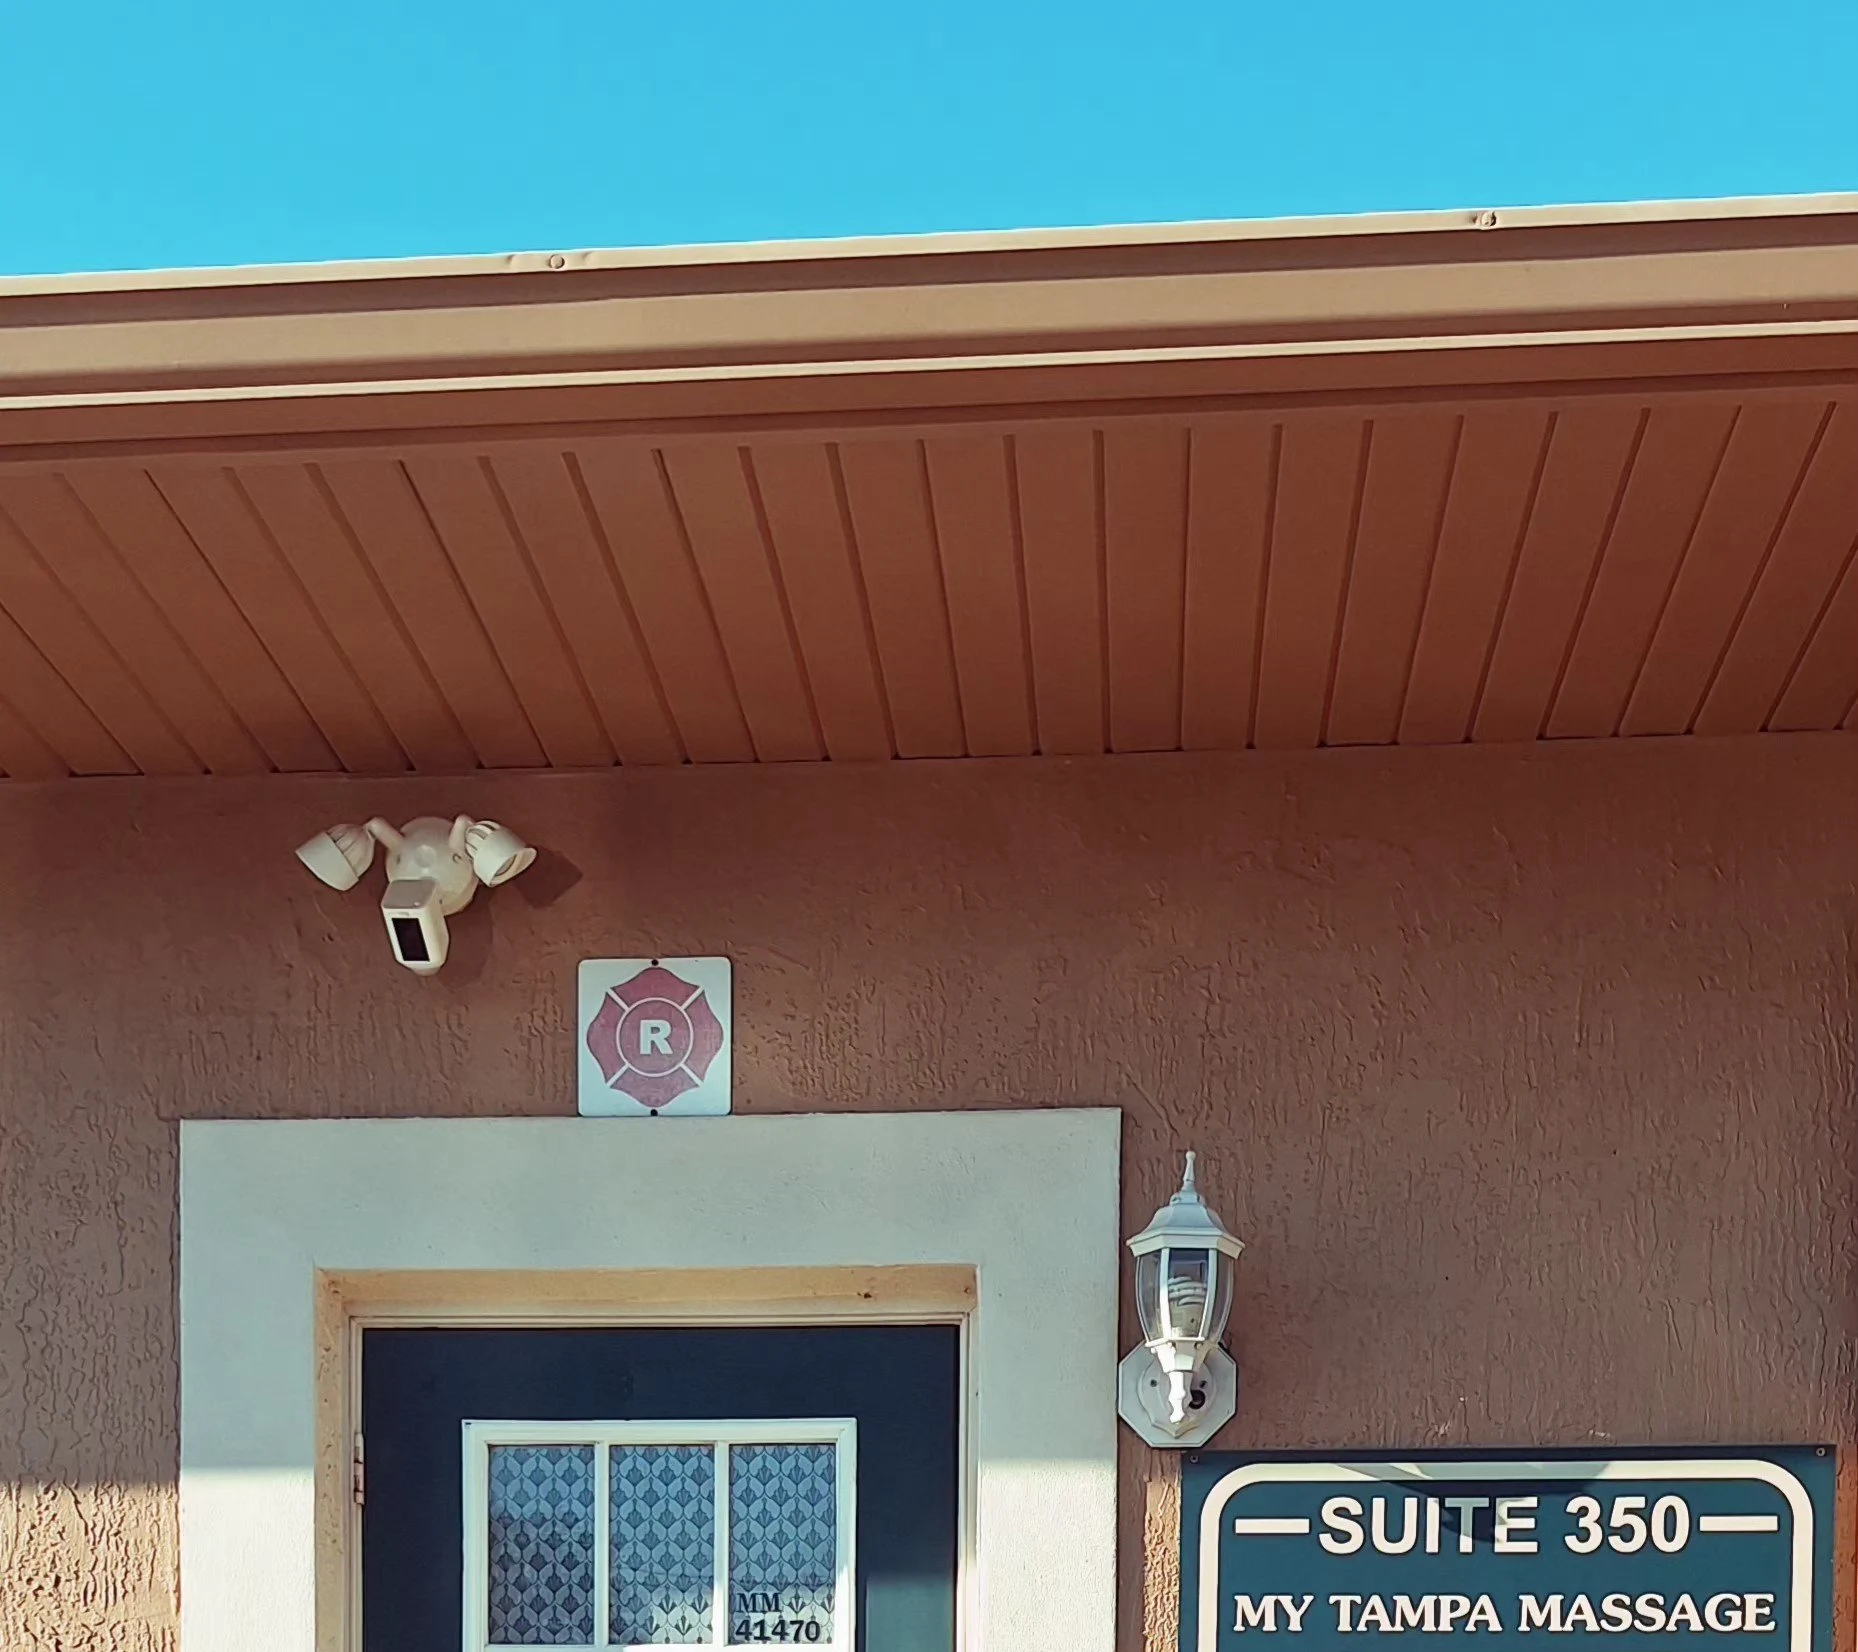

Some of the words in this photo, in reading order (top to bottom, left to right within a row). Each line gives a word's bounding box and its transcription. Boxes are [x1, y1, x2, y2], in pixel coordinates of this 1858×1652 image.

[639, 1019, 674, 1055] R
[1319, 1497, 1537, 1554] SUITE
[1565, 1496, 1689, 1553] 350
[736, 1592, 783, 1613] MM
[1234, 1596, 1314, 1631] MY
[1329, 1595, 1502, 1631] TAMPA
[1518, 1594, 1775, 1631] MASSAGE
[735, 1618, 821, 1643] 41470
